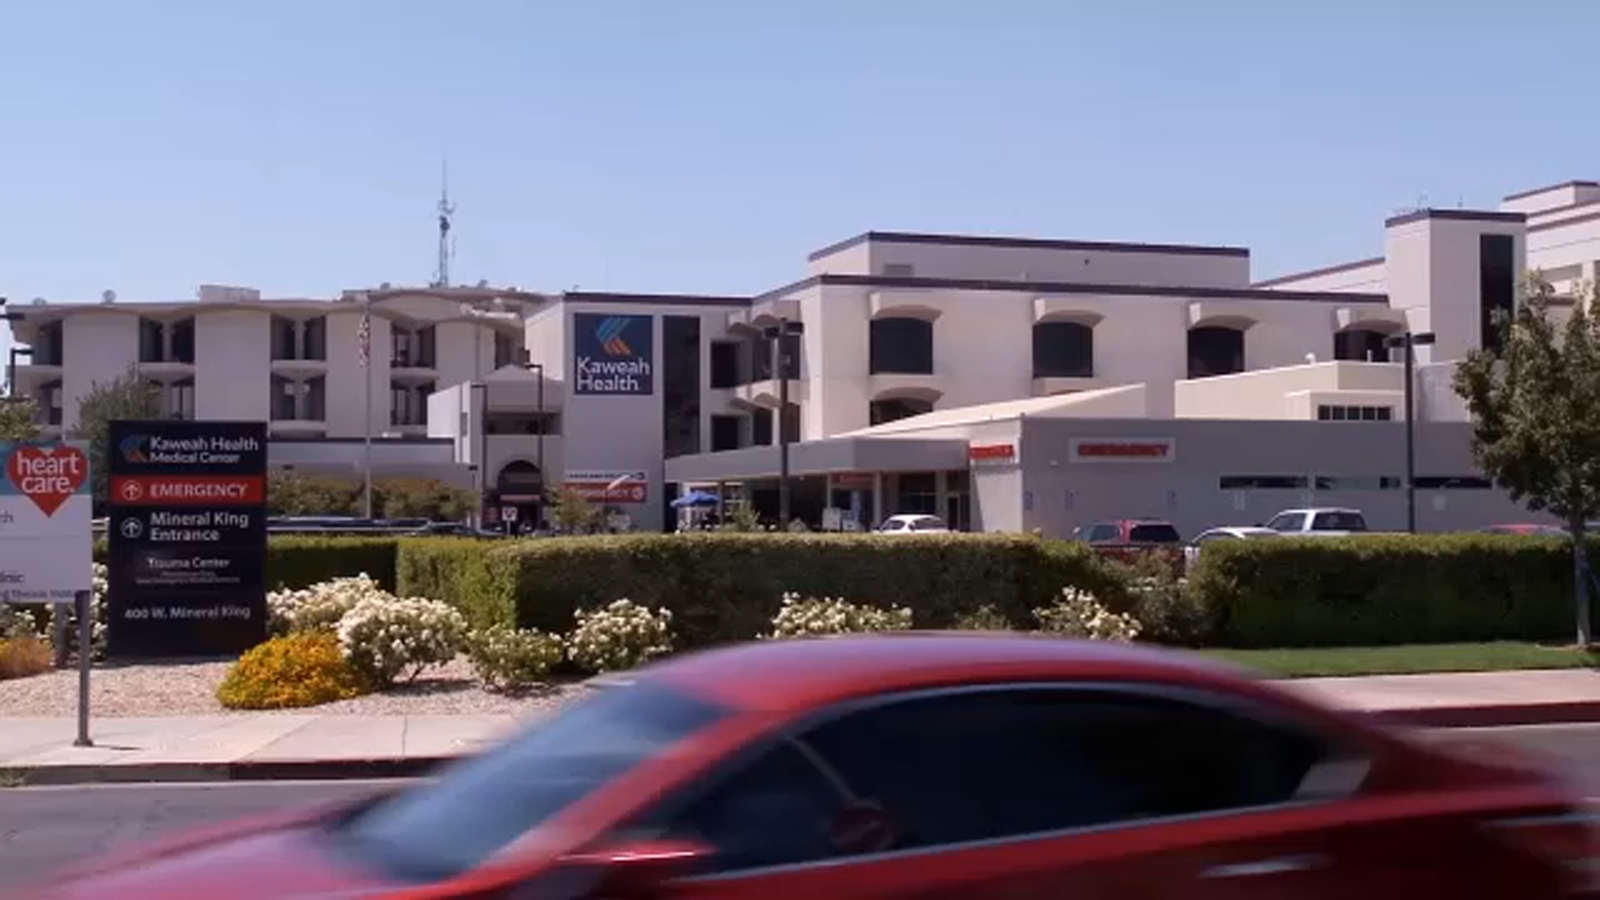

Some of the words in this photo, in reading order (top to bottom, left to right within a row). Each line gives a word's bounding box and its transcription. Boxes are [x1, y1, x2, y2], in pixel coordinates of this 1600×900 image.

[577, 356, 650, 375] Kaweah
[577, 375, 639, 391] Health
[151, 436, 207, 450] Kaweah
[211, 436, 259, 450] Health
[17, 450, 80, 475] heart
[151, 452, 197, 463] Medical
[200, 452, 240, 464] Center
[150, 483, 248, 497] EMERGENCY
[151, 512, 210, 526] Mineral
[214, 512, 249, 528] King
[151, 528, 220, 541] Entrance
[148, 558, 190, 568] Trauma
[192, 557, 230, 568] Center
[124, 608, 149, 619] 400
[152, 607, 168, 618] W.
[170, 607, 219, 618] Mineral
[221, 606, 250, 620] King
